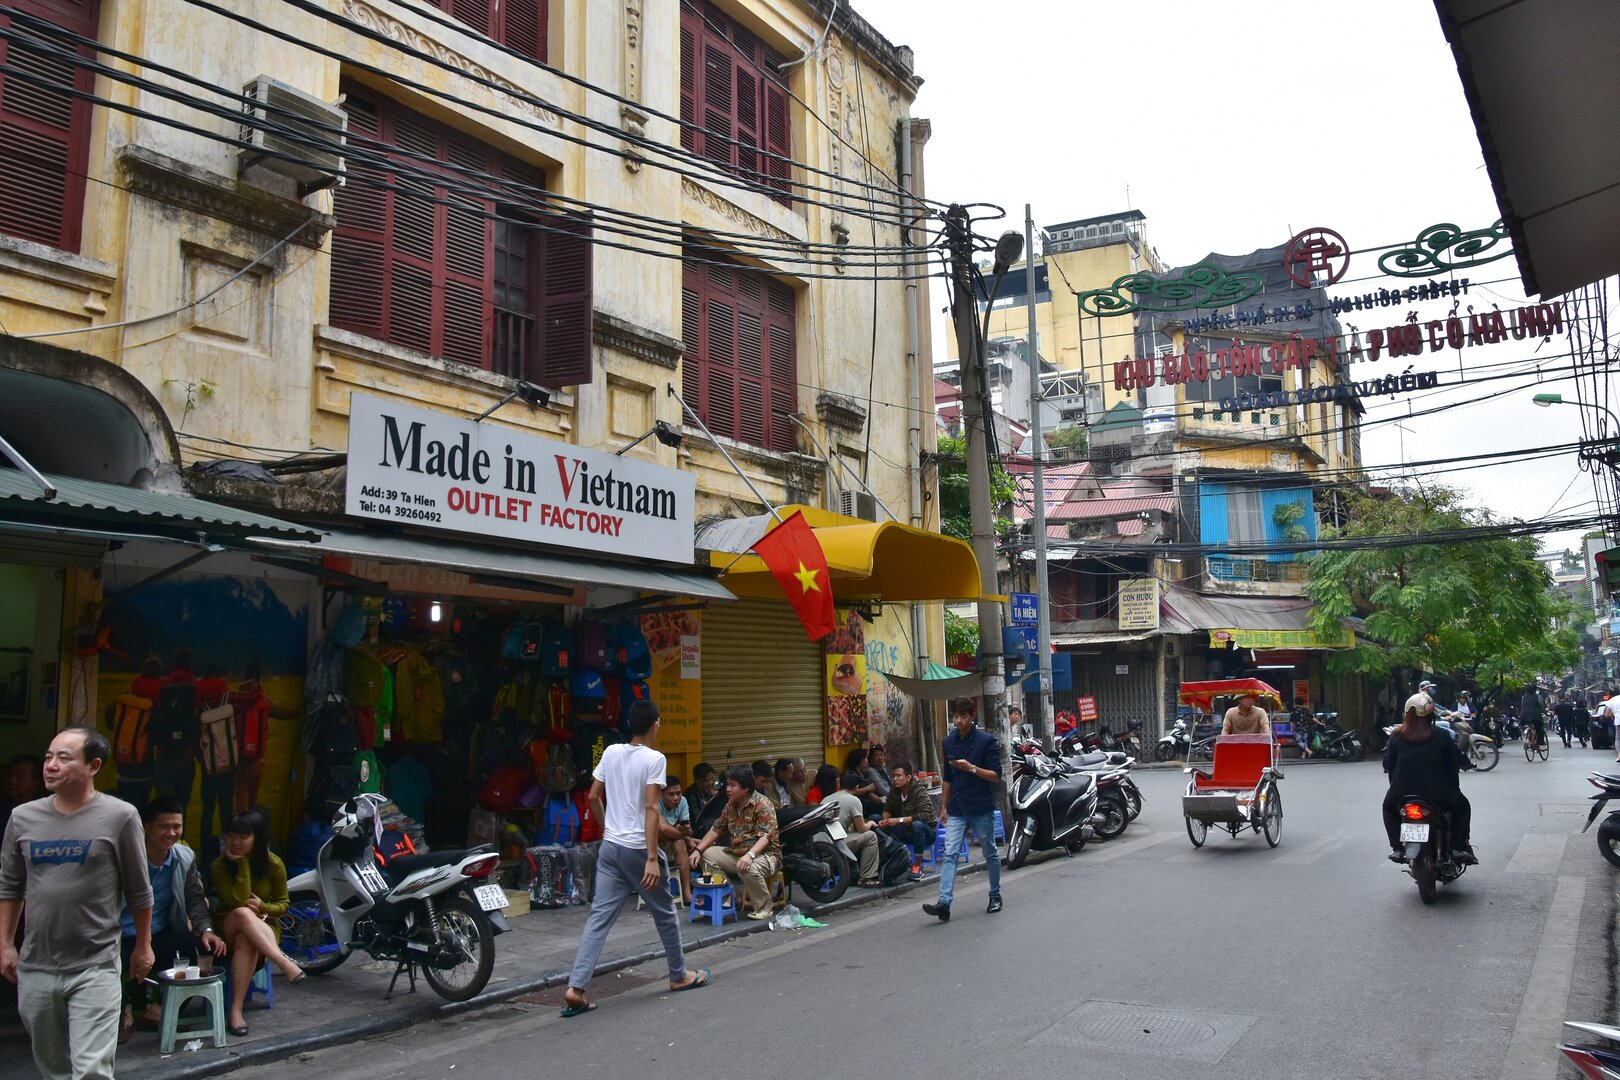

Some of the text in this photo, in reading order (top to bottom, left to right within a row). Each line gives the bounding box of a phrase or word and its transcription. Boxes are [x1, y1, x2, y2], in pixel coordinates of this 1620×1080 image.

[1113, 358, 1156, 392] KHU
[1164, 341, 1209, 386] BẢO
[1215, 336, 1262, 379] TỒN
[1270, 329, 1317, 374] CẤP
[379, 414, 677, 521] Made in Vietnam
[360, 500, 442, 523] Tel: 04 39260492
[401, 494, 411, 503] Ta
[414, 495, 436, 507] Hien
[447, 487, 624, 537] OUTLET FACTORY
[1022, 606, 1037, 621] HIỆN
